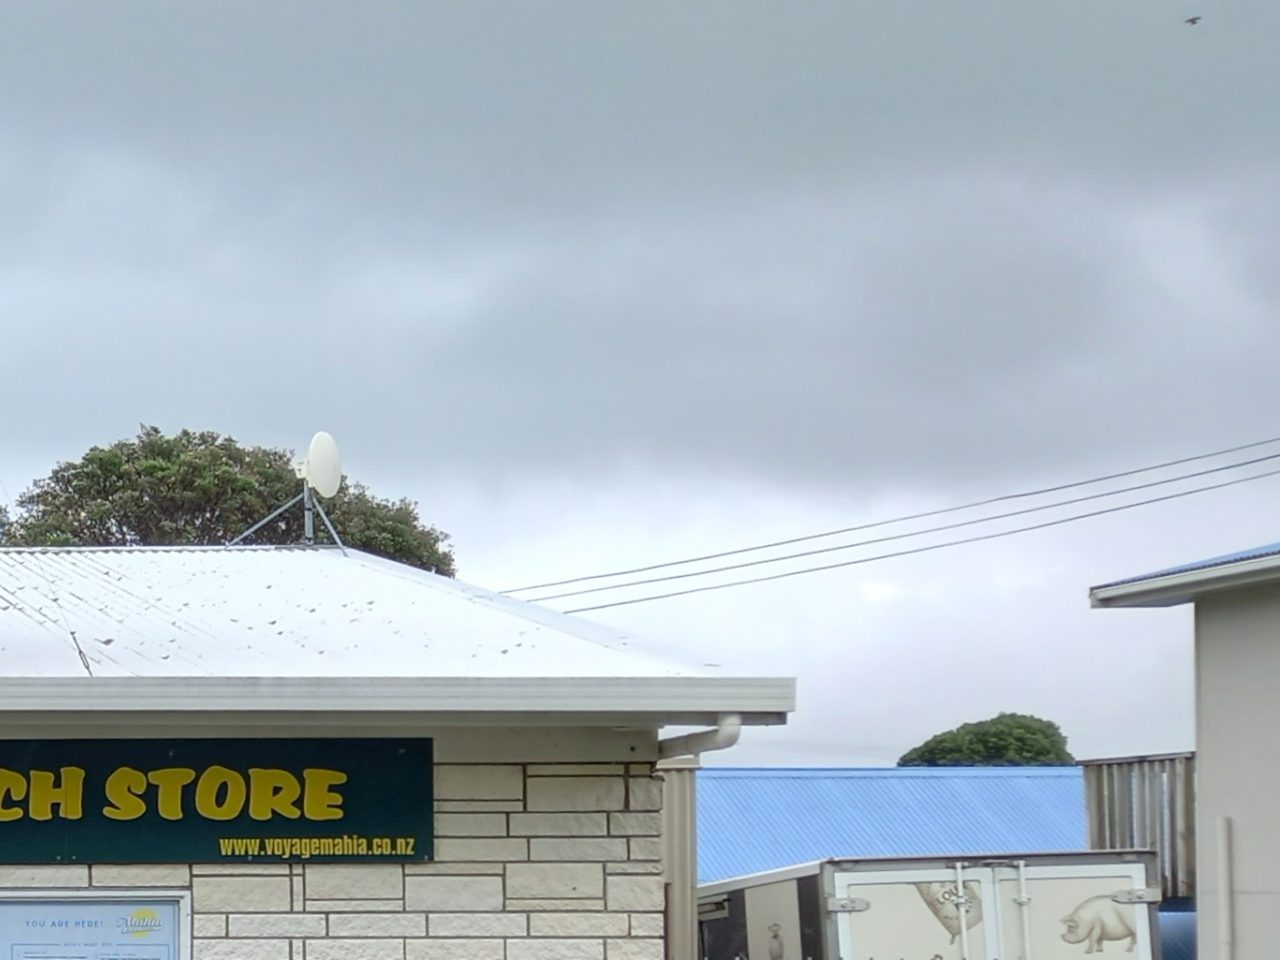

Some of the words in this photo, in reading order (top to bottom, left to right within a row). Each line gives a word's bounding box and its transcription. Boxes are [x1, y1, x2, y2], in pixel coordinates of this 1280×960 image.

[102, 764, 348, 822] STORE
[219, 834, 416, 859] www.voyagemahia.co.nz
[25, 919, 46, 928] YOU
[50, 919, 70, 928] ARE
